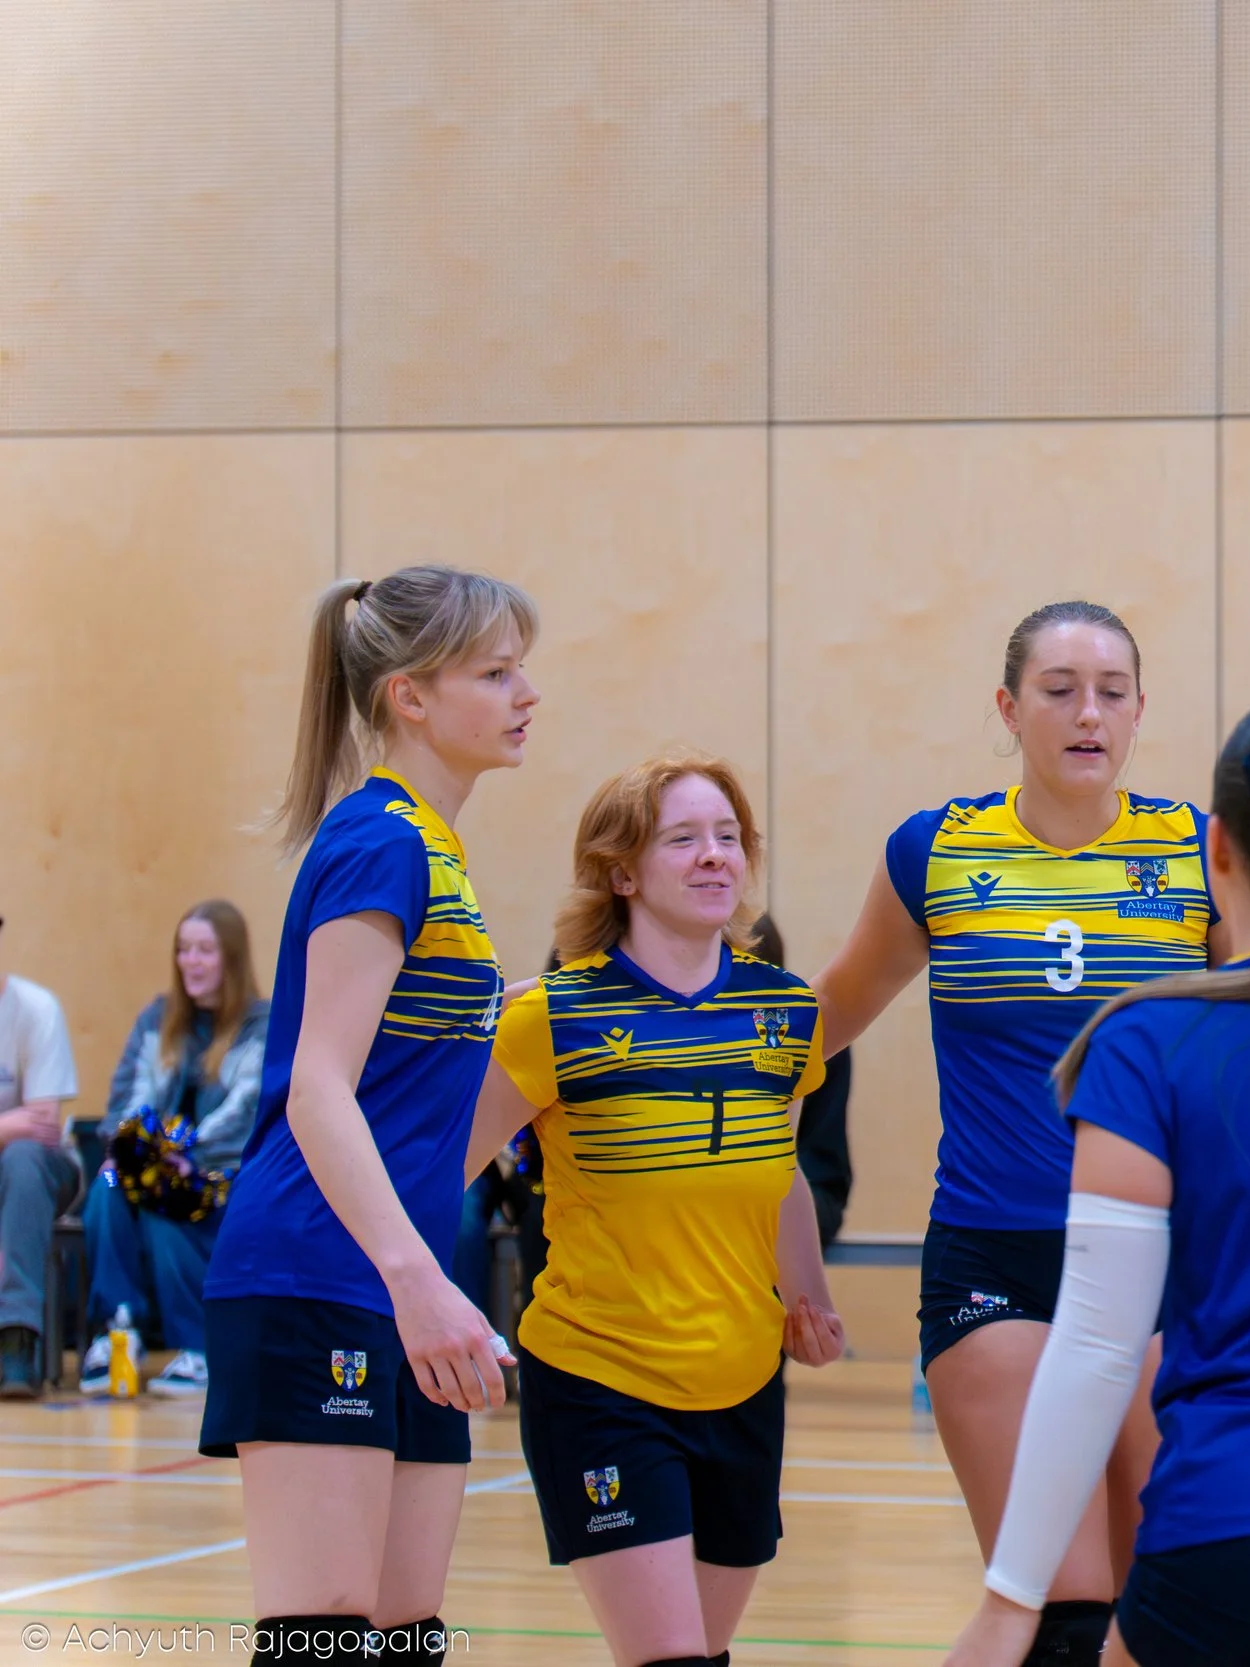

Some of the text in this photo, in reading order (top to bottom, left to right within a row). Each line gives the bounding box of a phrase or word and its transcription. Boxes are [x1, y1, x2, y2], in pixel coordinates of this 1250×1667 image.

[1126, 901, 1177, 913] Abertay
[1119, 909, 1184, 922] University
[1045, 919, 1084, 992] 3
[758, 1052, 790, 1066] Abertay
[327, 1396, 369, 1408] Abertay
[321, 1404, 374, 1417] University
[589, 1510, 628, 1525] Abertay
[586, 1516, 635, 1533] University
